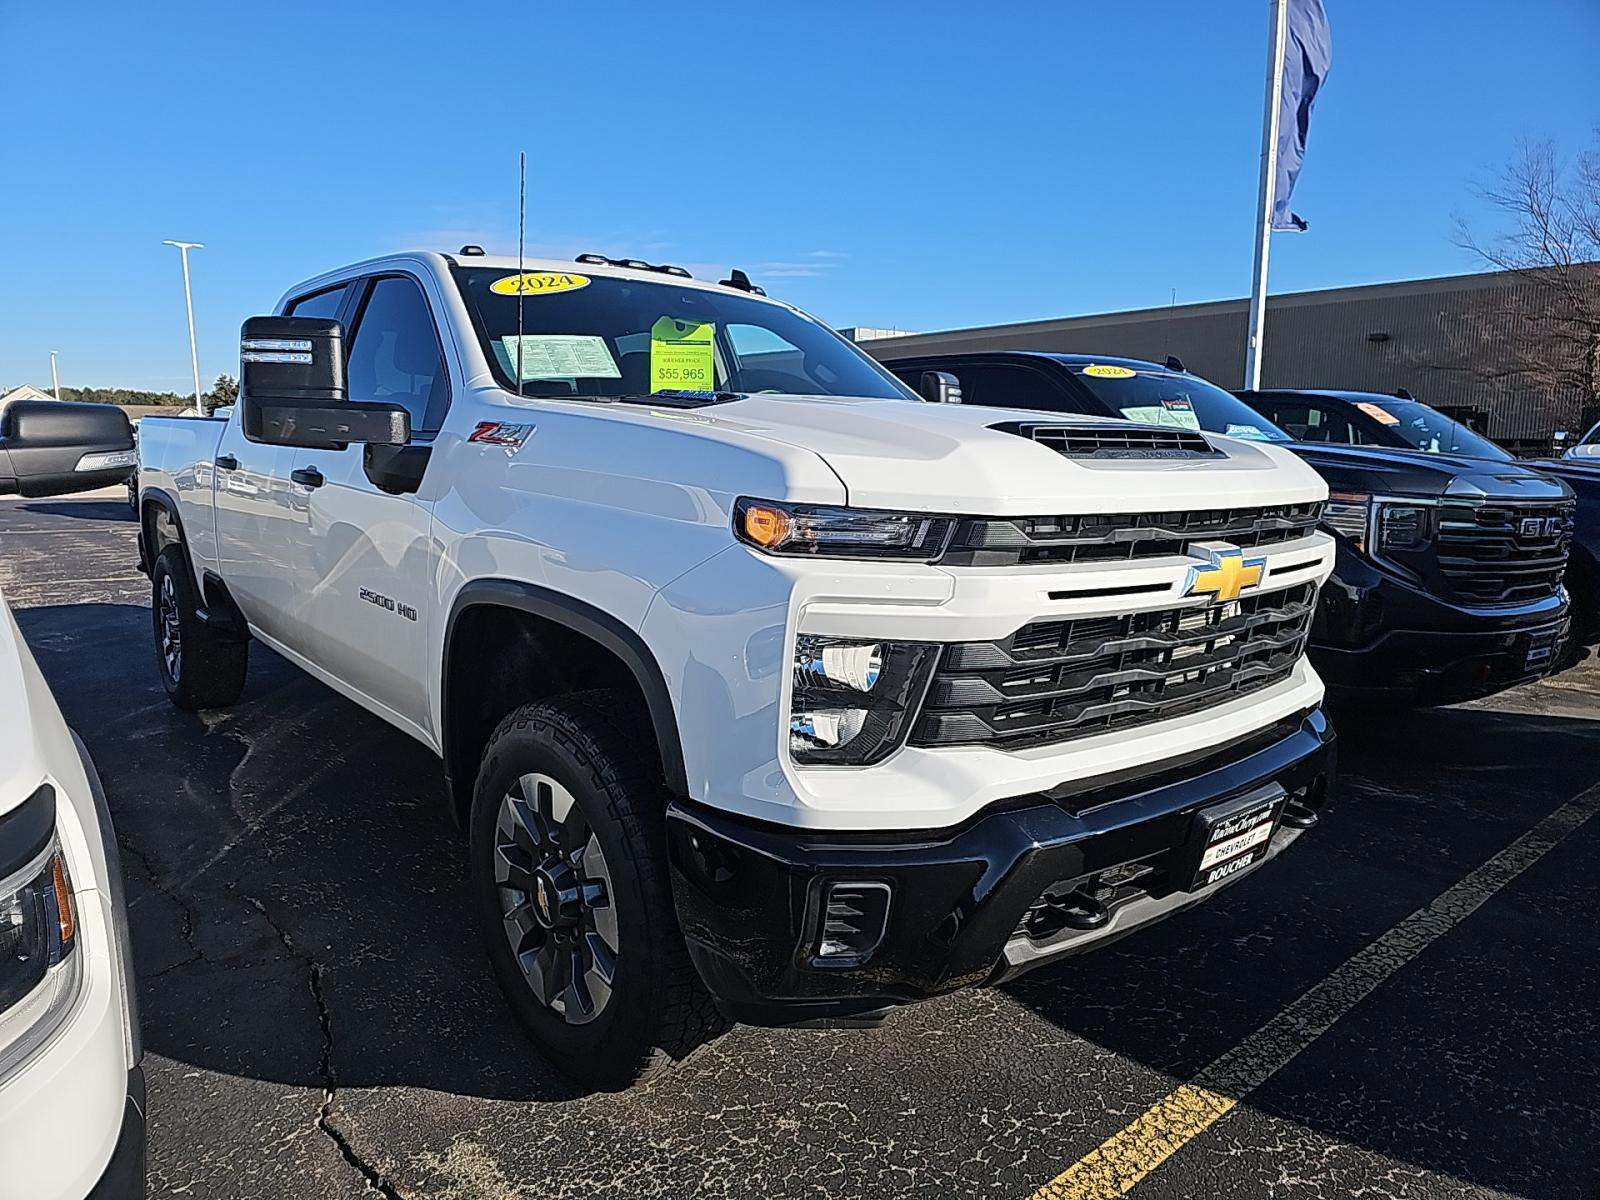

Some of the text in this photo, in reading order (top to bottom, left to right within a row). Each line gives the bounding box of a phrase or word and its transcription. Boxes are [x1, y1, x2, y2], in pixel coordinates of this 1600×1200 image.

[511, 275, 574, 292] 2024
[658, 367, 705, 381] $55,965
[359, 586, 418, 621] 2500 HD
[1215, 832, 1256, 859] CHEVROLET
[1208, 852, 1254, 884] BOUCHER
